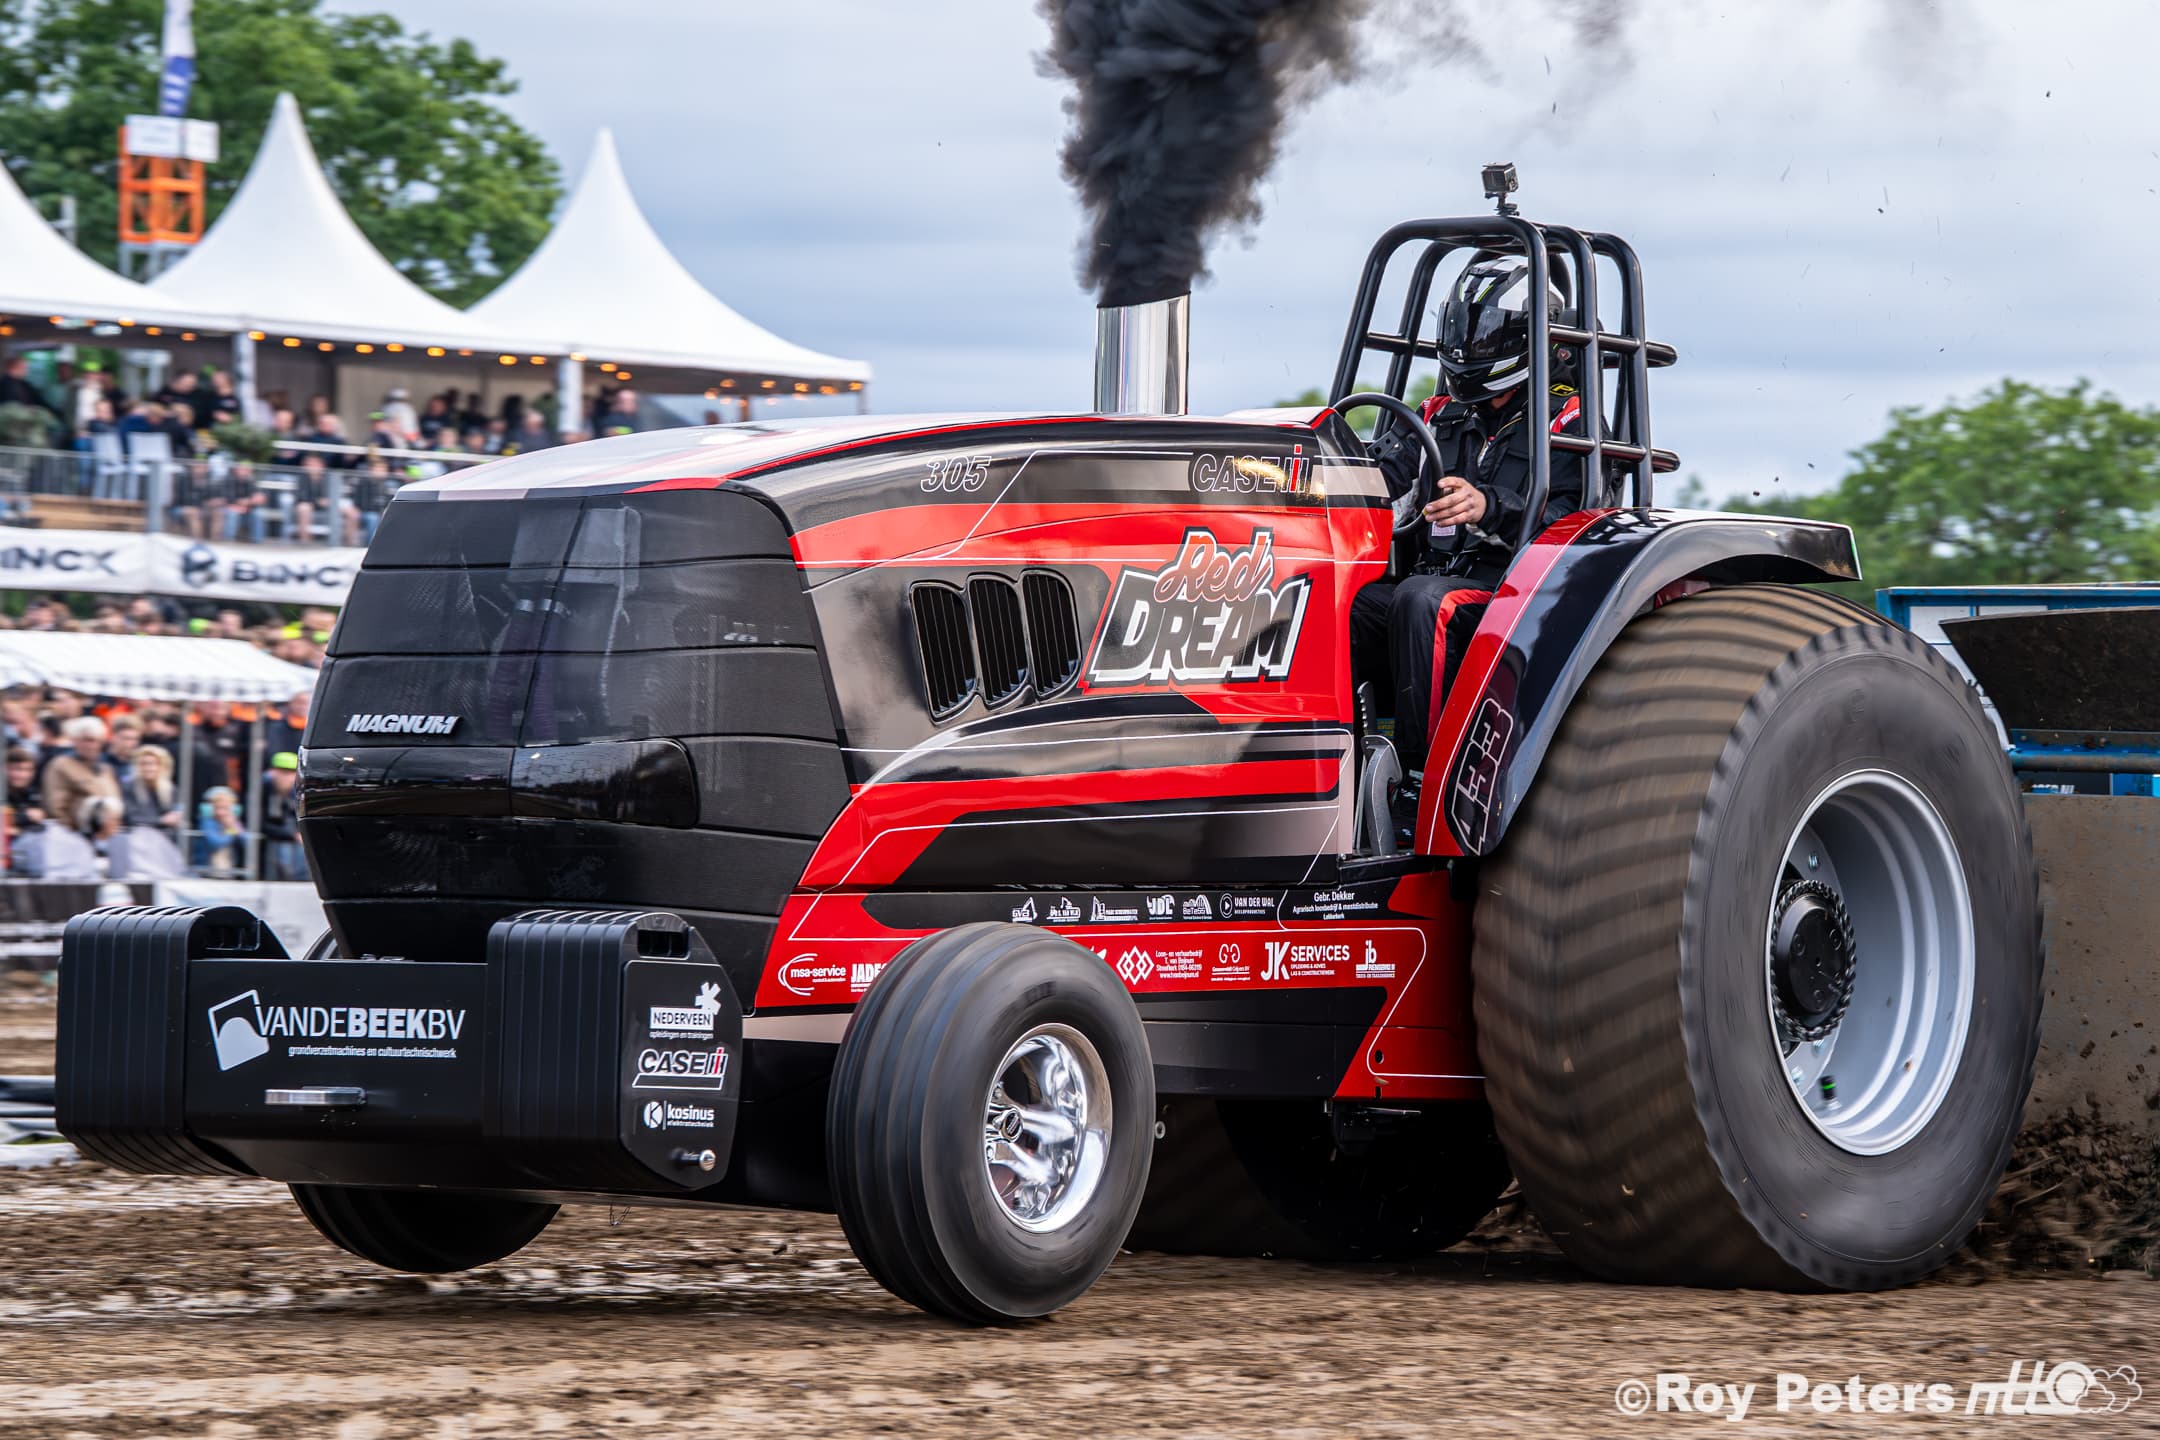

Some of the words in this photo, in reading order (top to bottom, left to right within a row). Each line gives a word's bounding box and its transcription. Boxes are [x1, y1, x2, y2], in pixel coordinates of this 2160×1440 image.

[920, 455, 992, 493] 305
[1193, 453, 1281, 493] CASE
[231, 560, 352, 587] BINC
[1154, 527, 1274, 603] Red
[1090, 569, 1311, 682] DREAM
[345, 713, 460, 734] MAGNUM
[1451, 698, 1514, 857] 433
[1234, 897, 1248, 907] VAN
[1249, 897, 1261, 907] DER
[1261, 897, 1275, 907] WAL
[1314, 892, 1331, 902] Gebr.
[1332, 891, 1355, 901] Dekker
[791, 964, 846, 978] msa-service
[1261, 942, 1290, 981] JK
[653, 1012, 711, 1026] NEDERVEEN
[367, 1047, 377, 1056] en
[638, 1049, 707, 1074] CASE
[667, 1104, 714, 1121] kosinus
